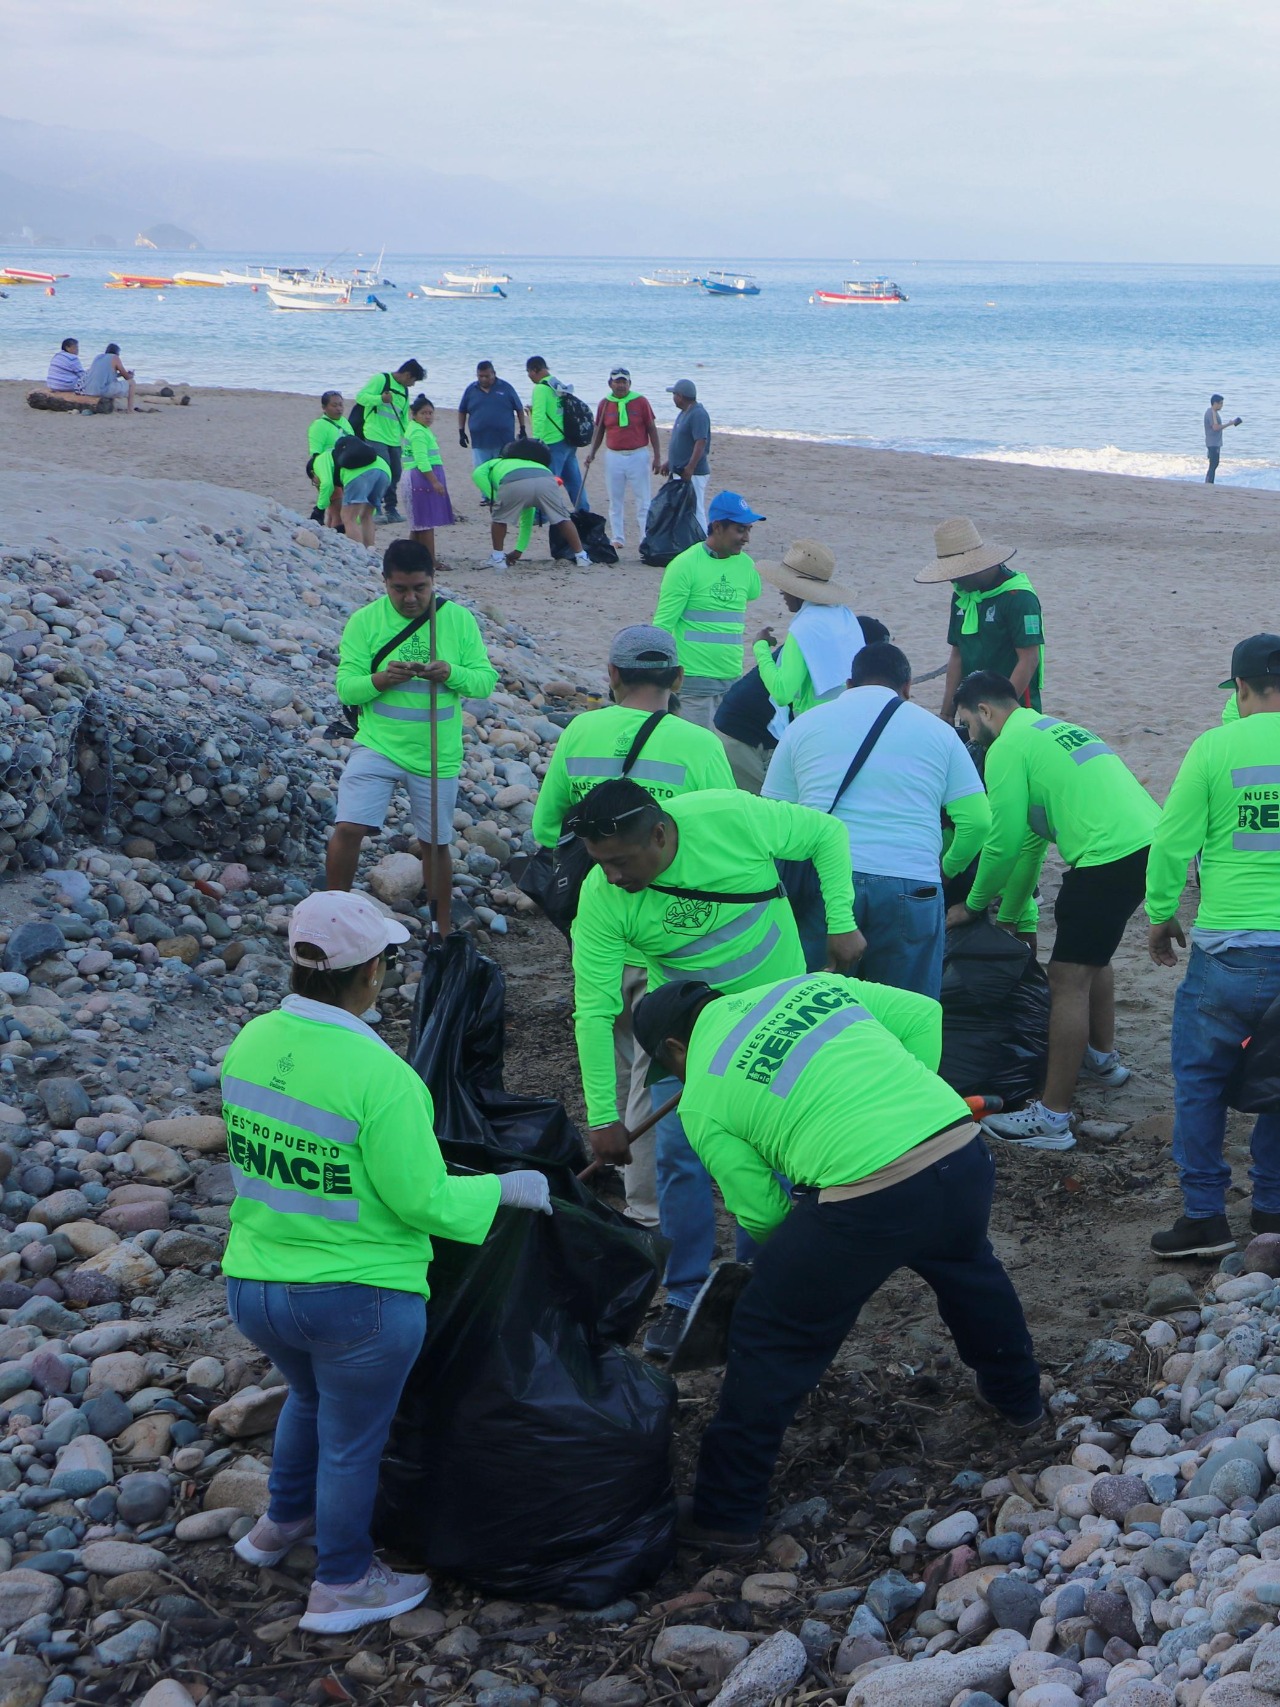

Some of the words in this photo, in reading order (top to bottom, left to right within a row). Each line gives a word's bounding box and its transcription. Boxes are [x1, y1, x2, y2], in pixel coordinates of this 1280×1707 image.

[736, 1012, 786, 1071] NUESTRO
[784, 981, 831, 1010] PUERTO
[227, 1130, 353, 1195] ENACE
[273, 1131, 340, 1160] PUERTO
